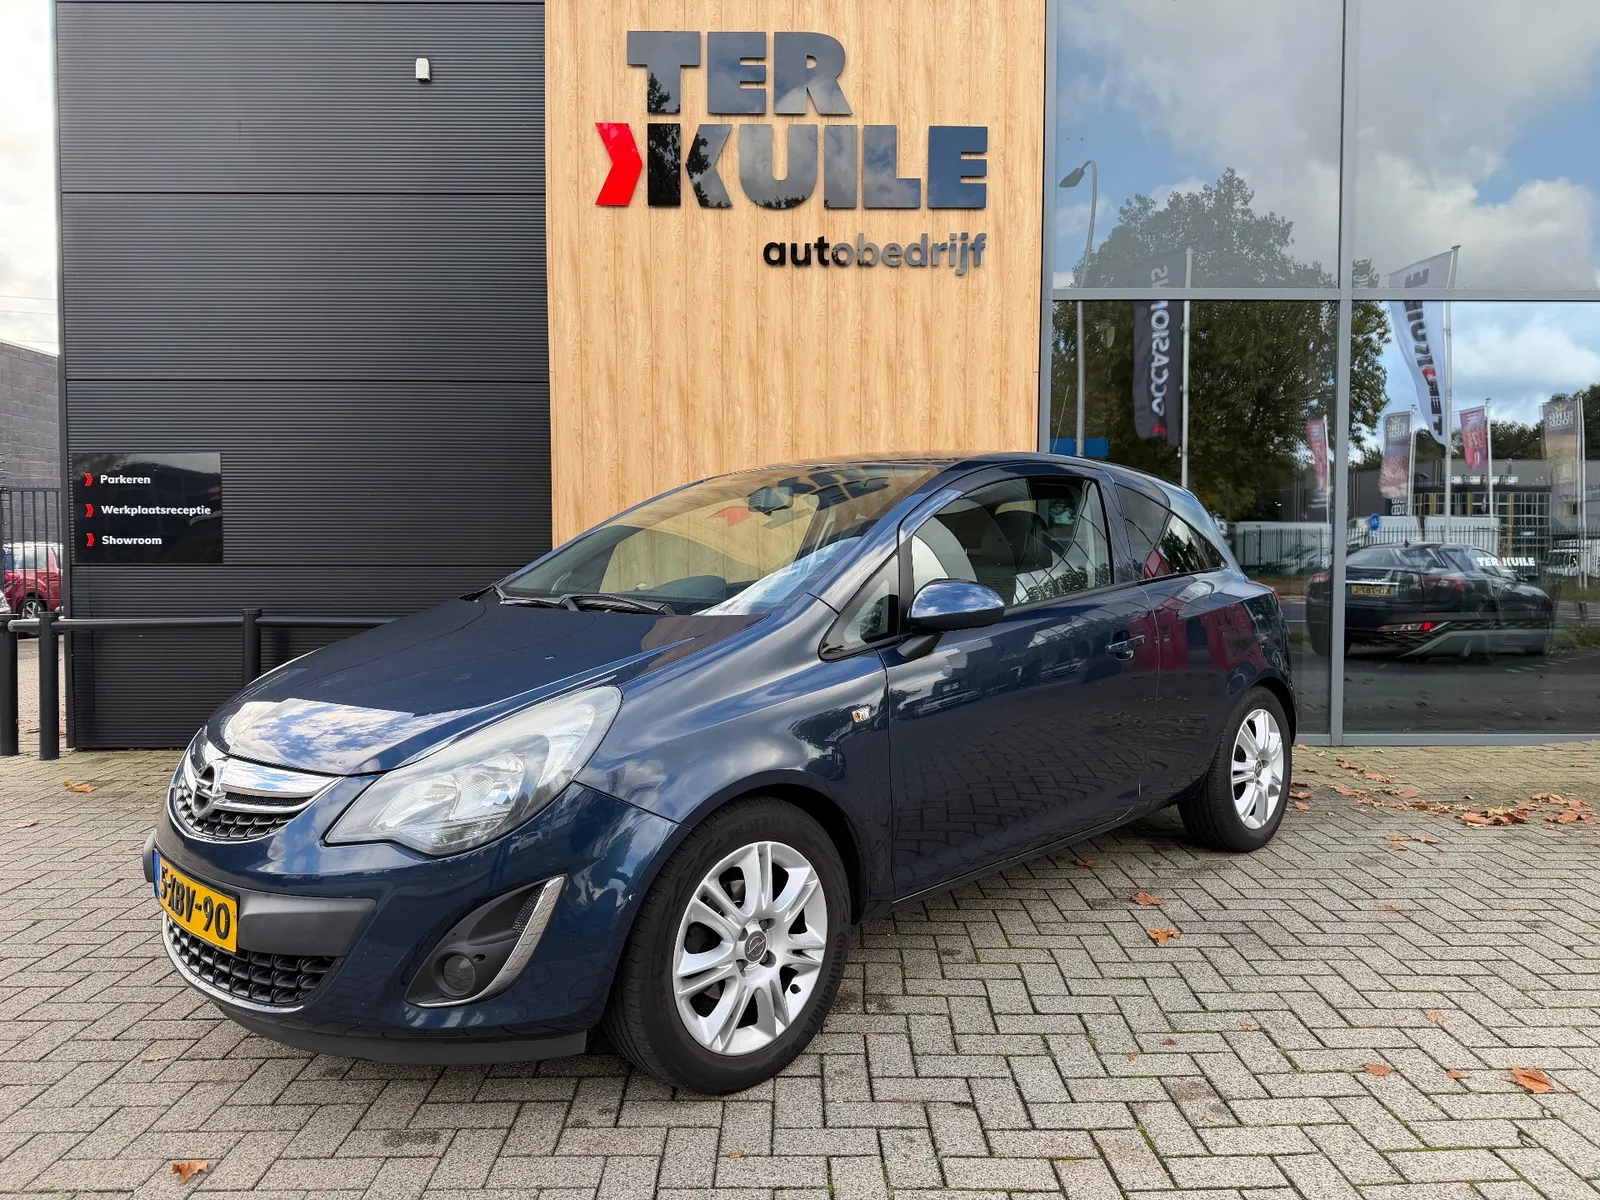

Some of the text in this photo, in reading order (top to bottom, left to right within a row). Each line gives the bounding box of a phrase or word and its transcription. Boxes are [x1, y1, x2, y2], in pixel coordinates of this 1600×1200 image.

[626, 30, 852, 115] TER
[647, 122, 988, 209] KUILE
[762, 232, 988, 275] autobedrijf
[100, 474, 151, 484] Parkeren
[101, 505, 211, 516] Werkplaatsreceptie
[102, 535, 162, 545] Showroom
[1477, 557, 1536, 567] TER KUILE
[808, 931, 848, 1027] Continental
